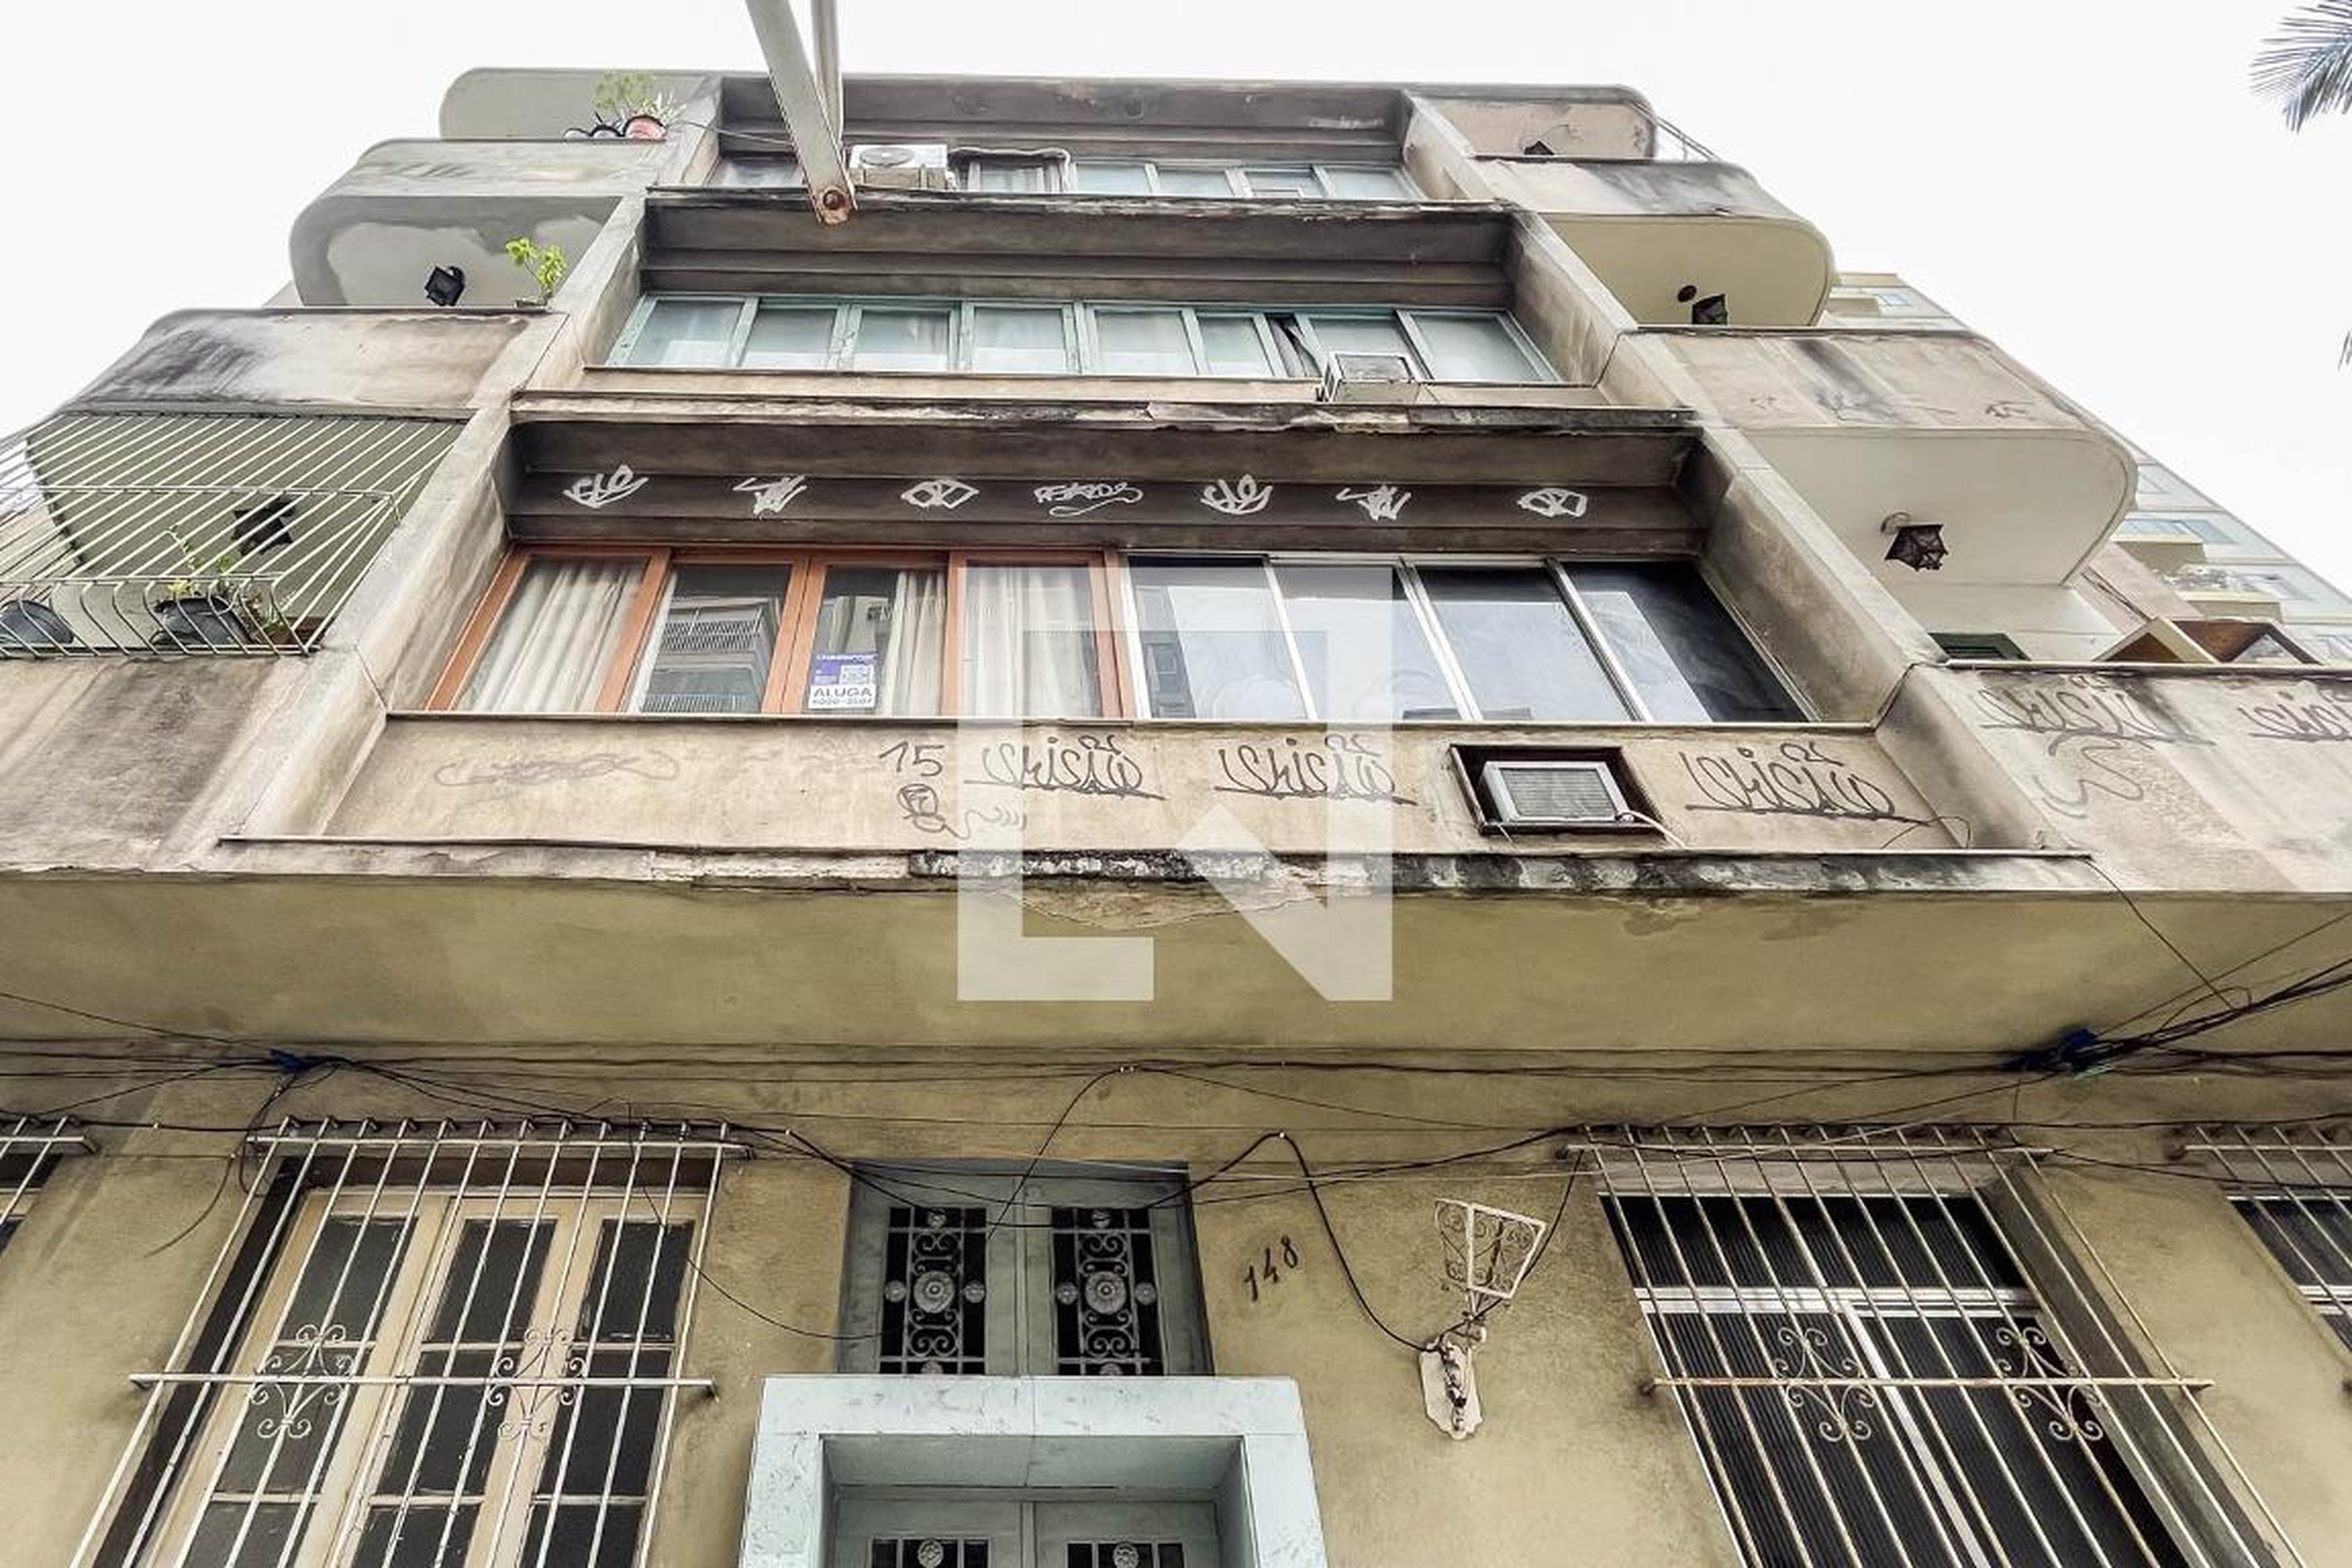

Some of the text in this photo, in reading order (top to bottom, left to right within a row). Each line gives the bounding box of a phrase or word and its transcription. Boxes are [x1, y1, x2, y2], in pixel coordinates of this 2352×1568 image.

[813, 687, 873, 698] ALUGA
[878, 741, 945, 777] 15
[1243, 1234, 1298, 1302] 148
